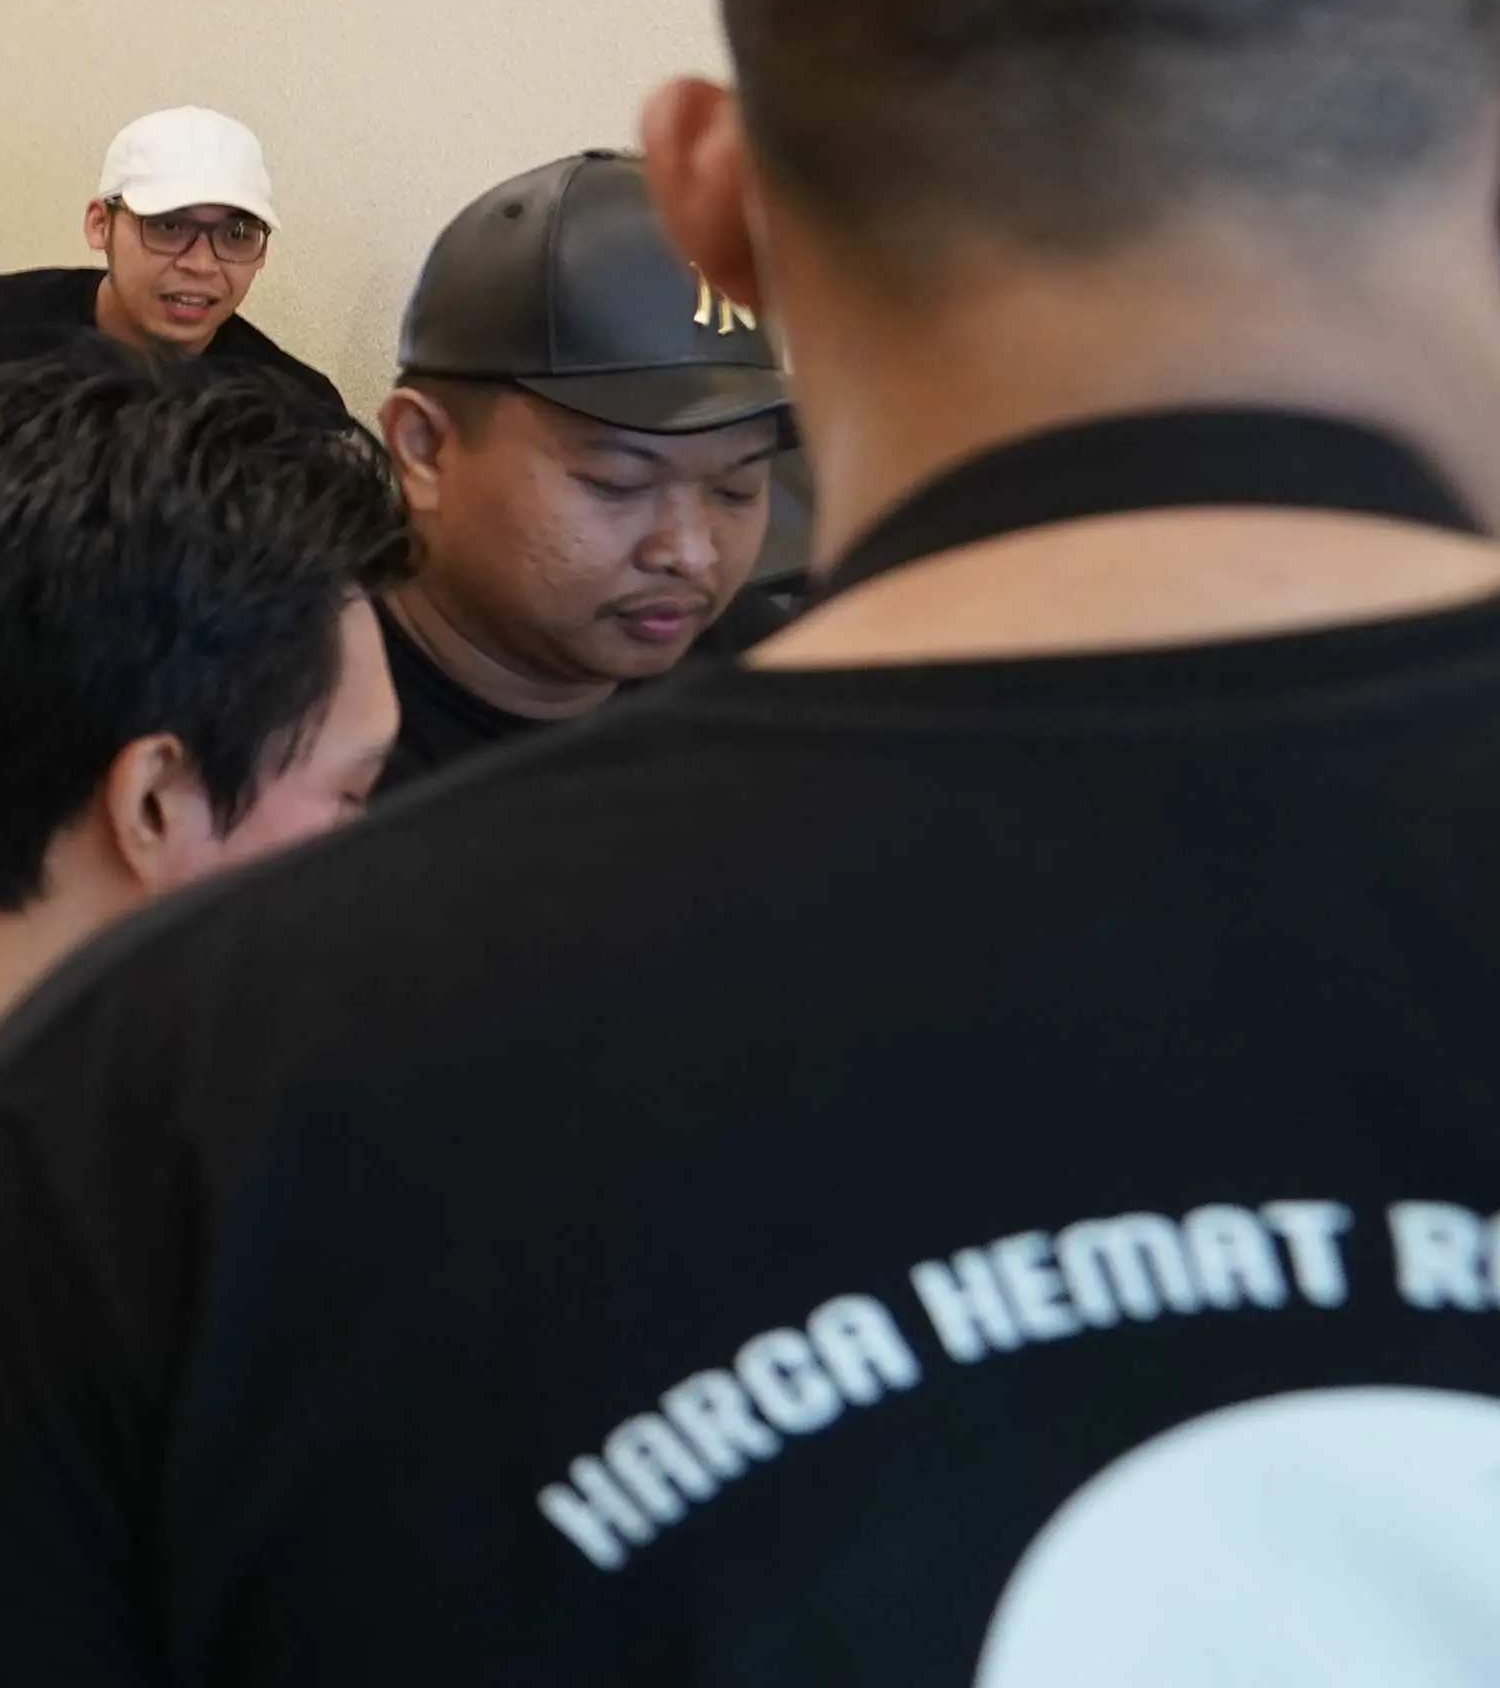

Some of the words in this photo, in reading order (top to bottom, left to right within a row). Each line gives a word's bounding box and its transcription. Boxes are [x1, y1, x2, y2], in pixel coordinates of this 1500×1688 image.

[537, 1292, 923, 1572] HARGA
[910, 1199, 1353, 1364] HEMAT
[1385, 1199, 1500, 1313] R
